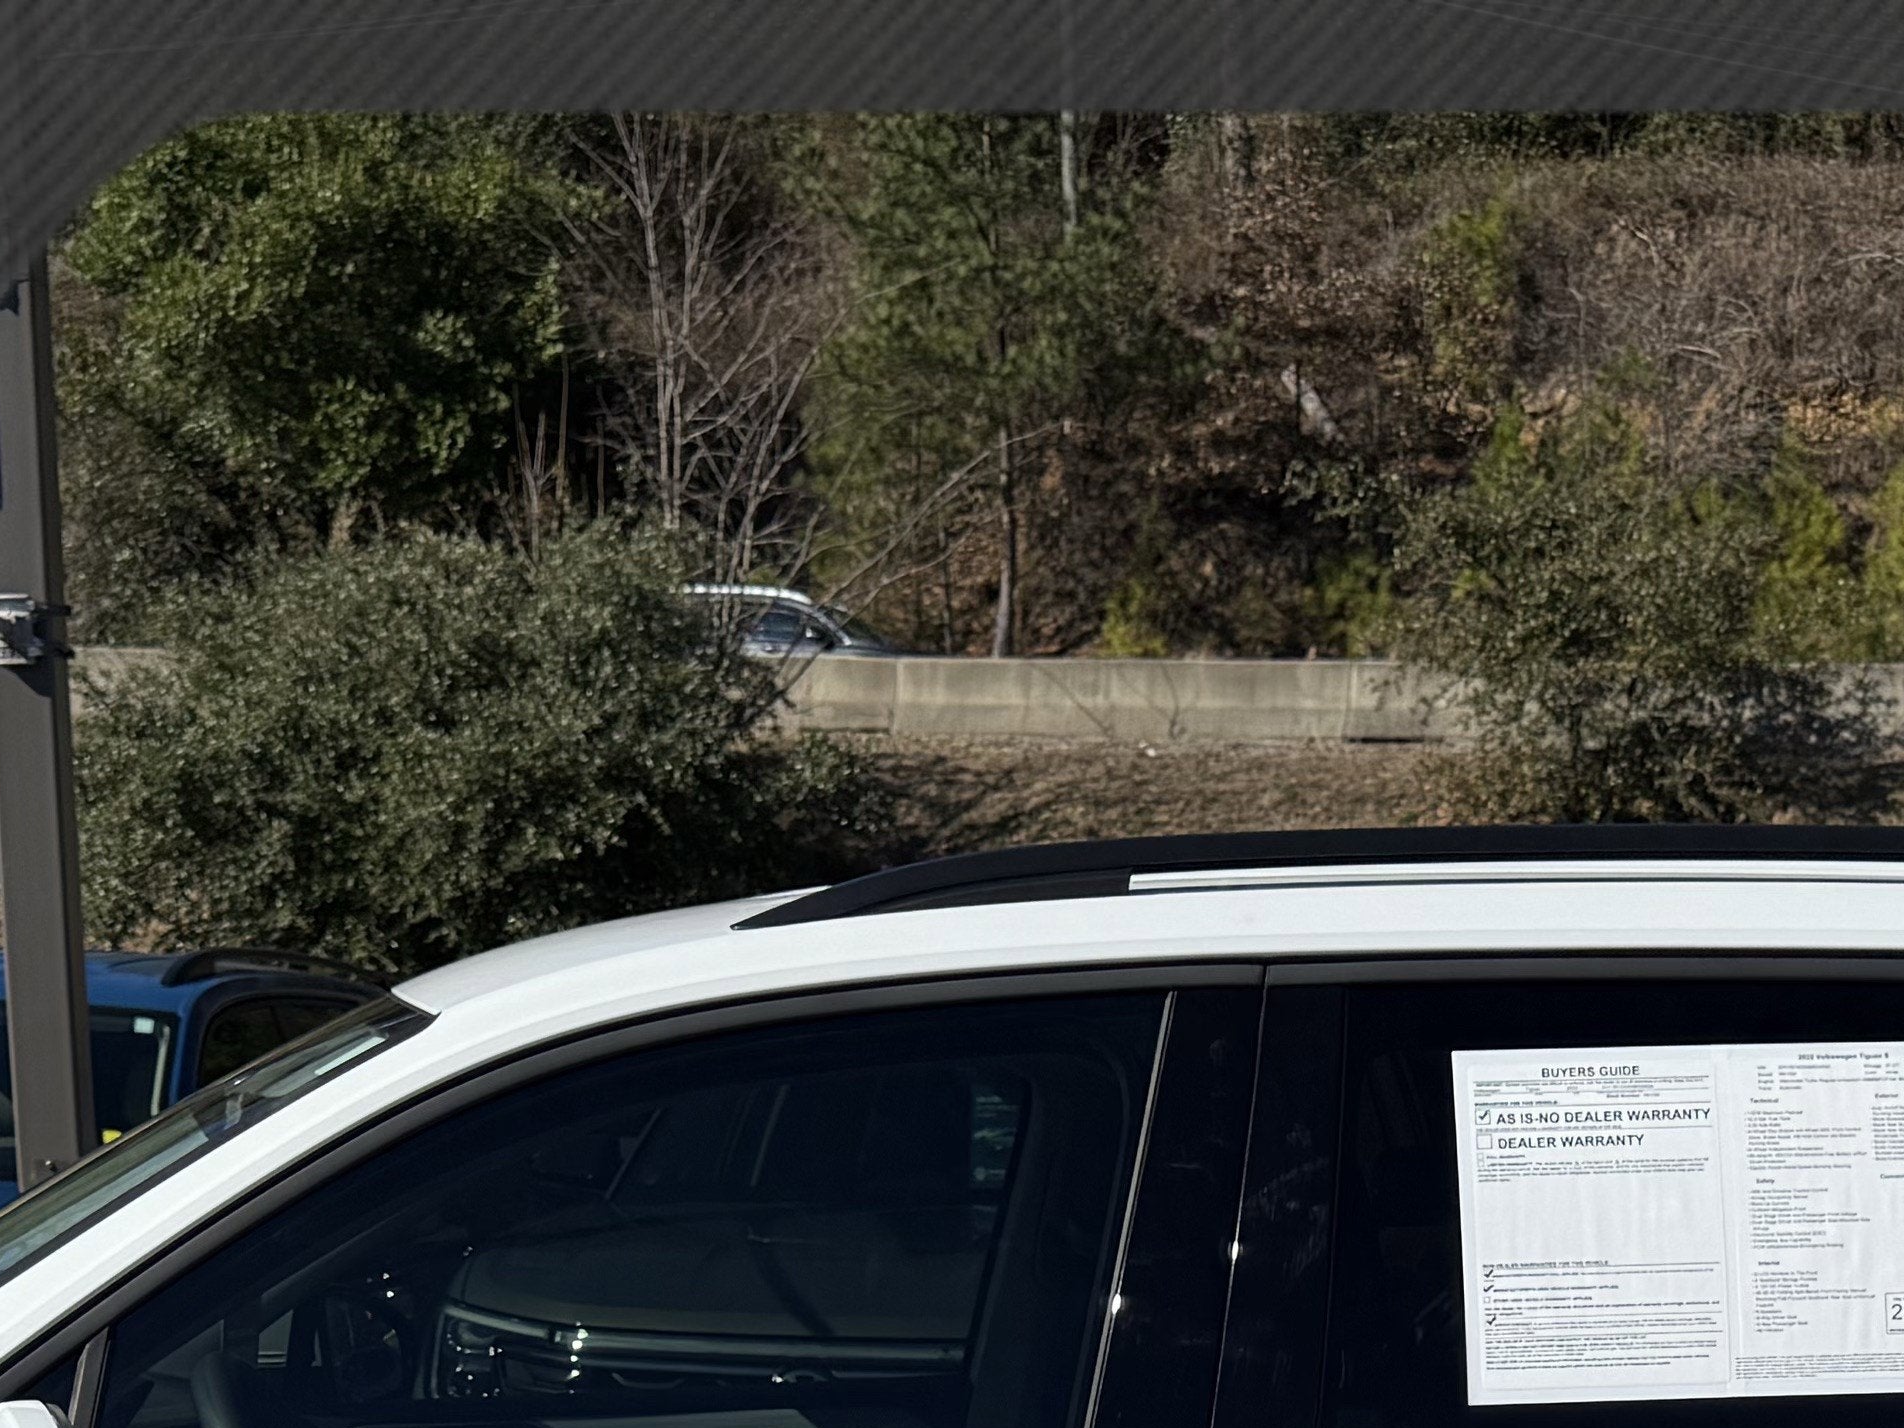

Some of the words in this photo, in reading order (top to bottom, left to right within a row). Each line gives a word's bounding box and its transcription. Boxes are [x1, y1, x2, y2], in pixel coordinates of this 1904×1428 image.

[1541, 1067, 1595, 1079] BUYERS
[1599, 1065, 1640, 1077] GUIDE
[1496, 1113, 1516, 1125] AS
[1520, 1111, 1560, 1125] IS-NO
[1565, 1110, 1623, 1123] DEALER
[1627, 1108, 1712, 1122] WARRANTY
[1498, 1136, 1557, 1150] DEALER
[1560, 1134, 1645, 1148] WARRANTY
